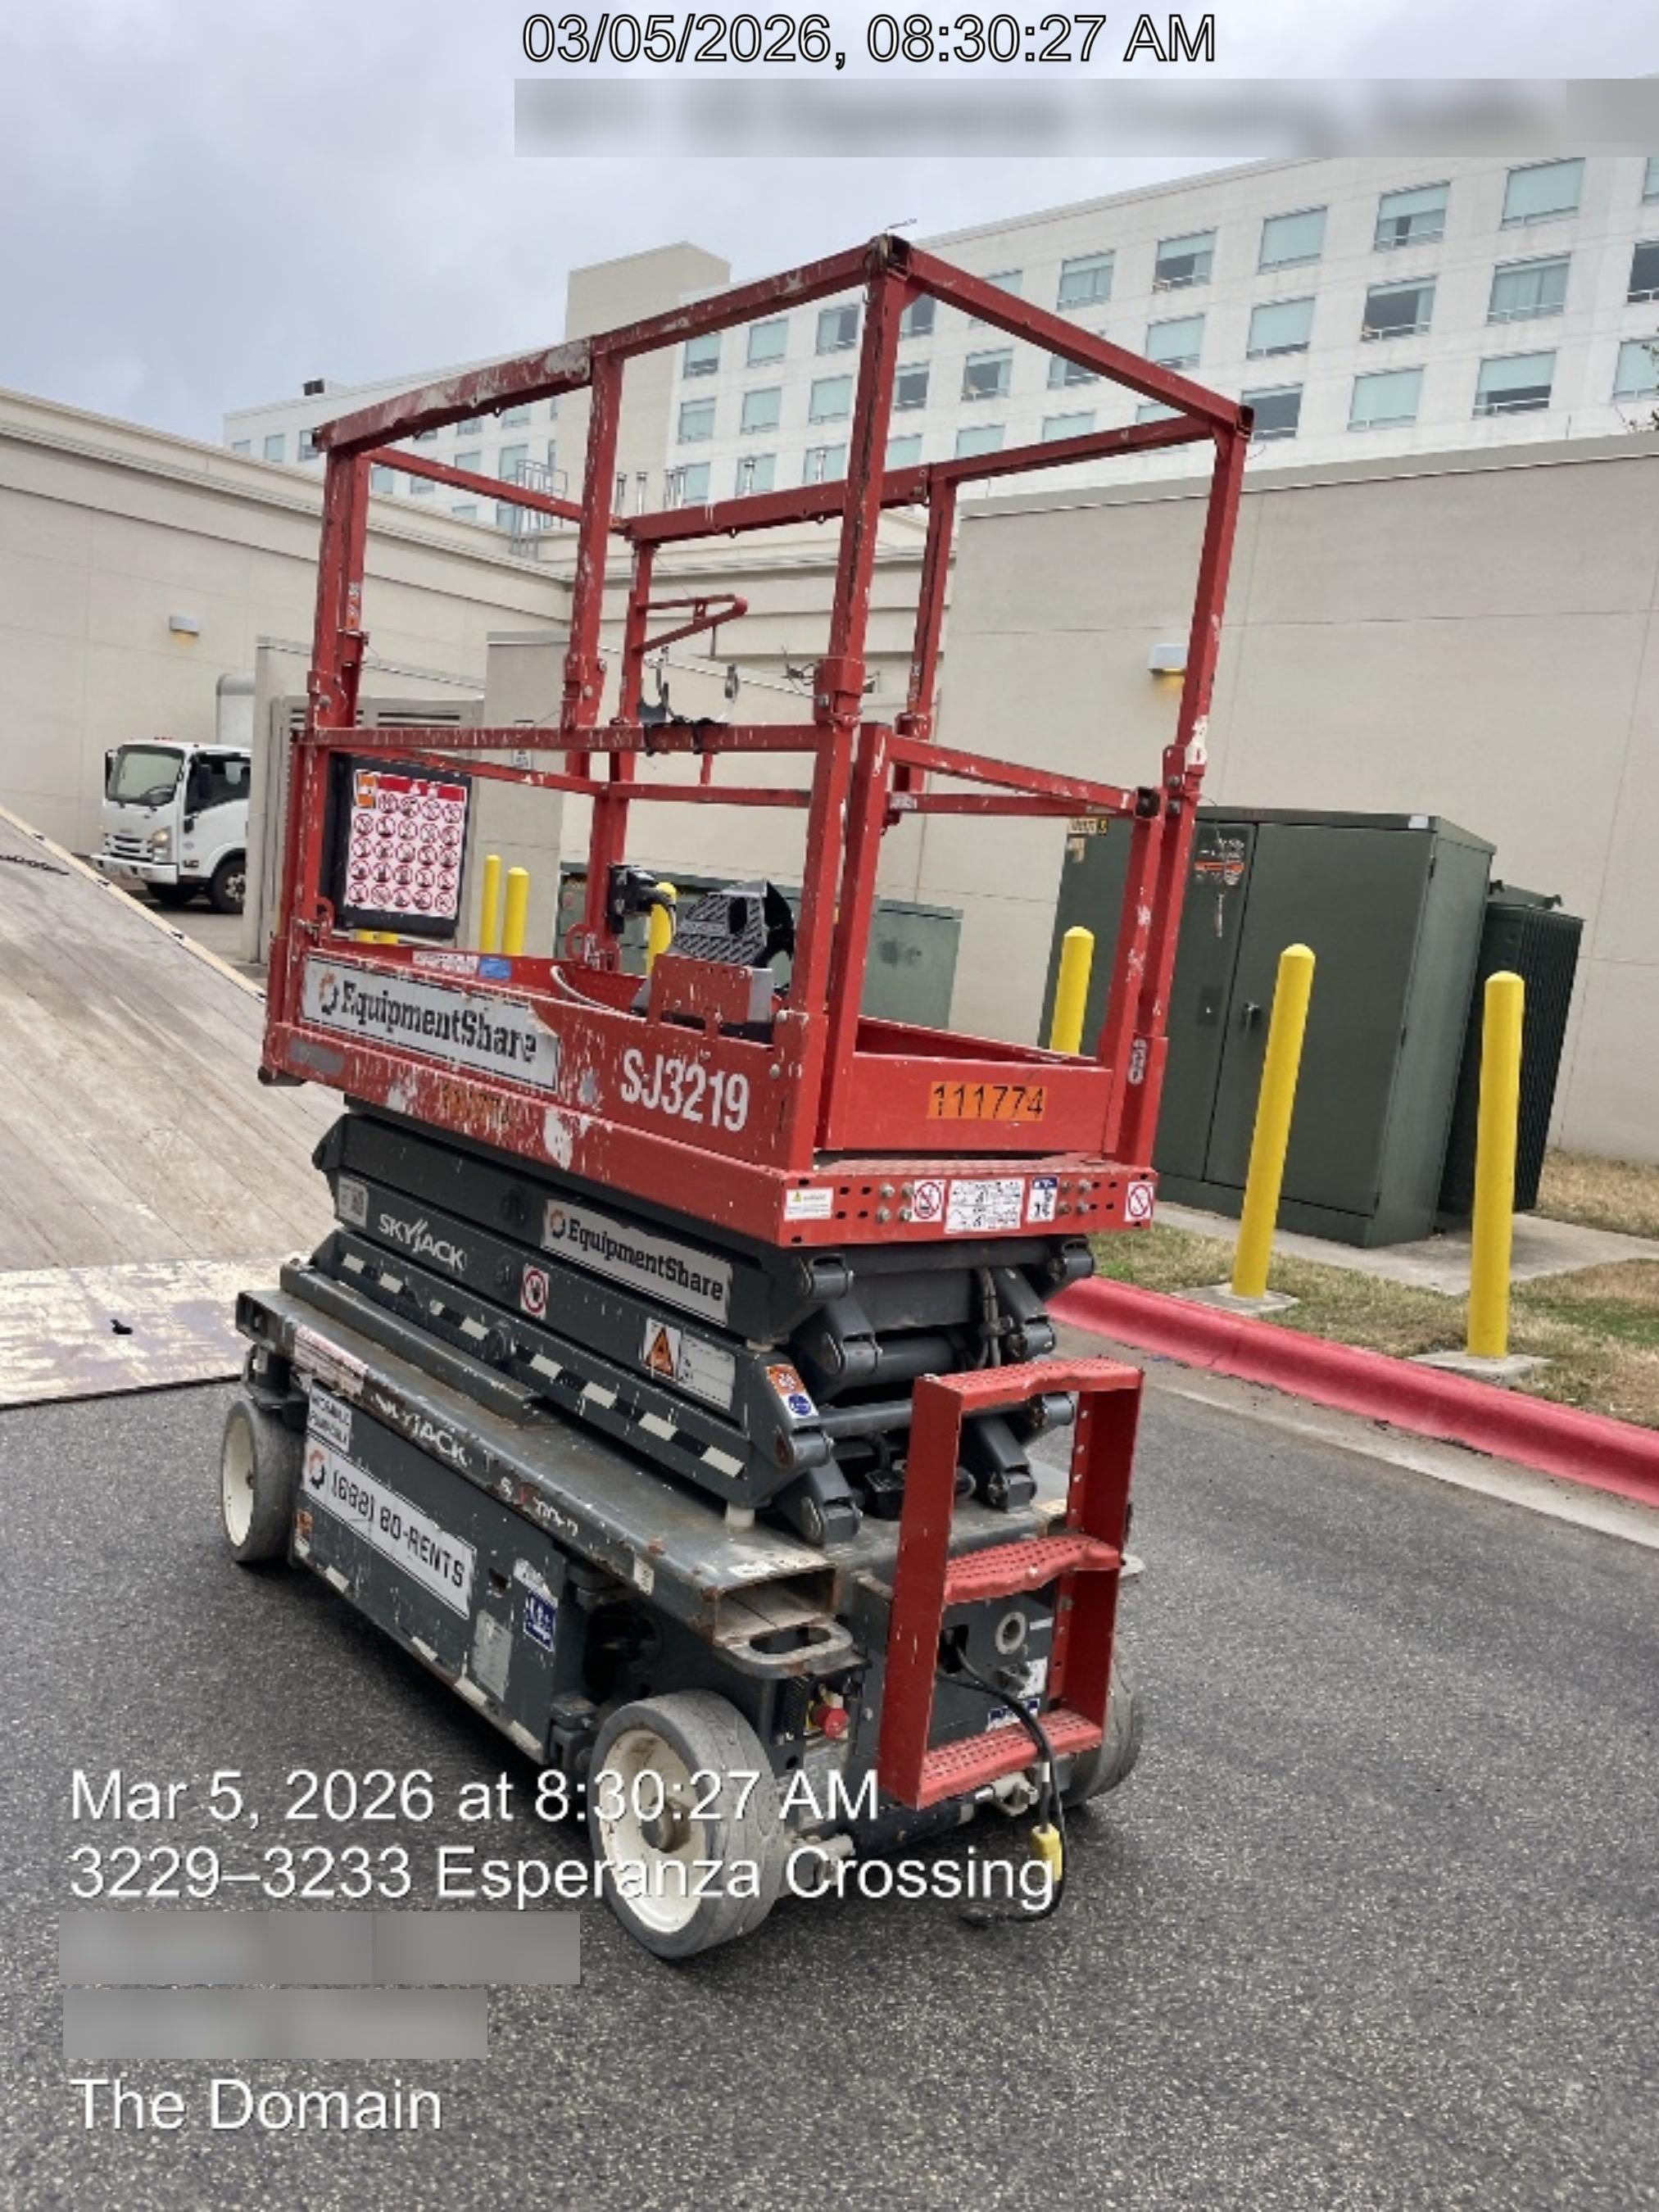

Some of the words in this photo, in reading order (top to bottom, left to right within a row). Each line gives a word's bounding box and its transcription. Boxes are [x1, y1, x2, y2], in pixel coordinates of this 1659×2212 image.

[341, 980, 537, 1064] EquipmentShare
[620, 1048, 750, 1131] SJ3219
[932, 1084, 1044, 1118] 111774
[378, 1213, 467, 1271] SKYJACK
[567, 1219, 723, 1301] EquipmentShare
